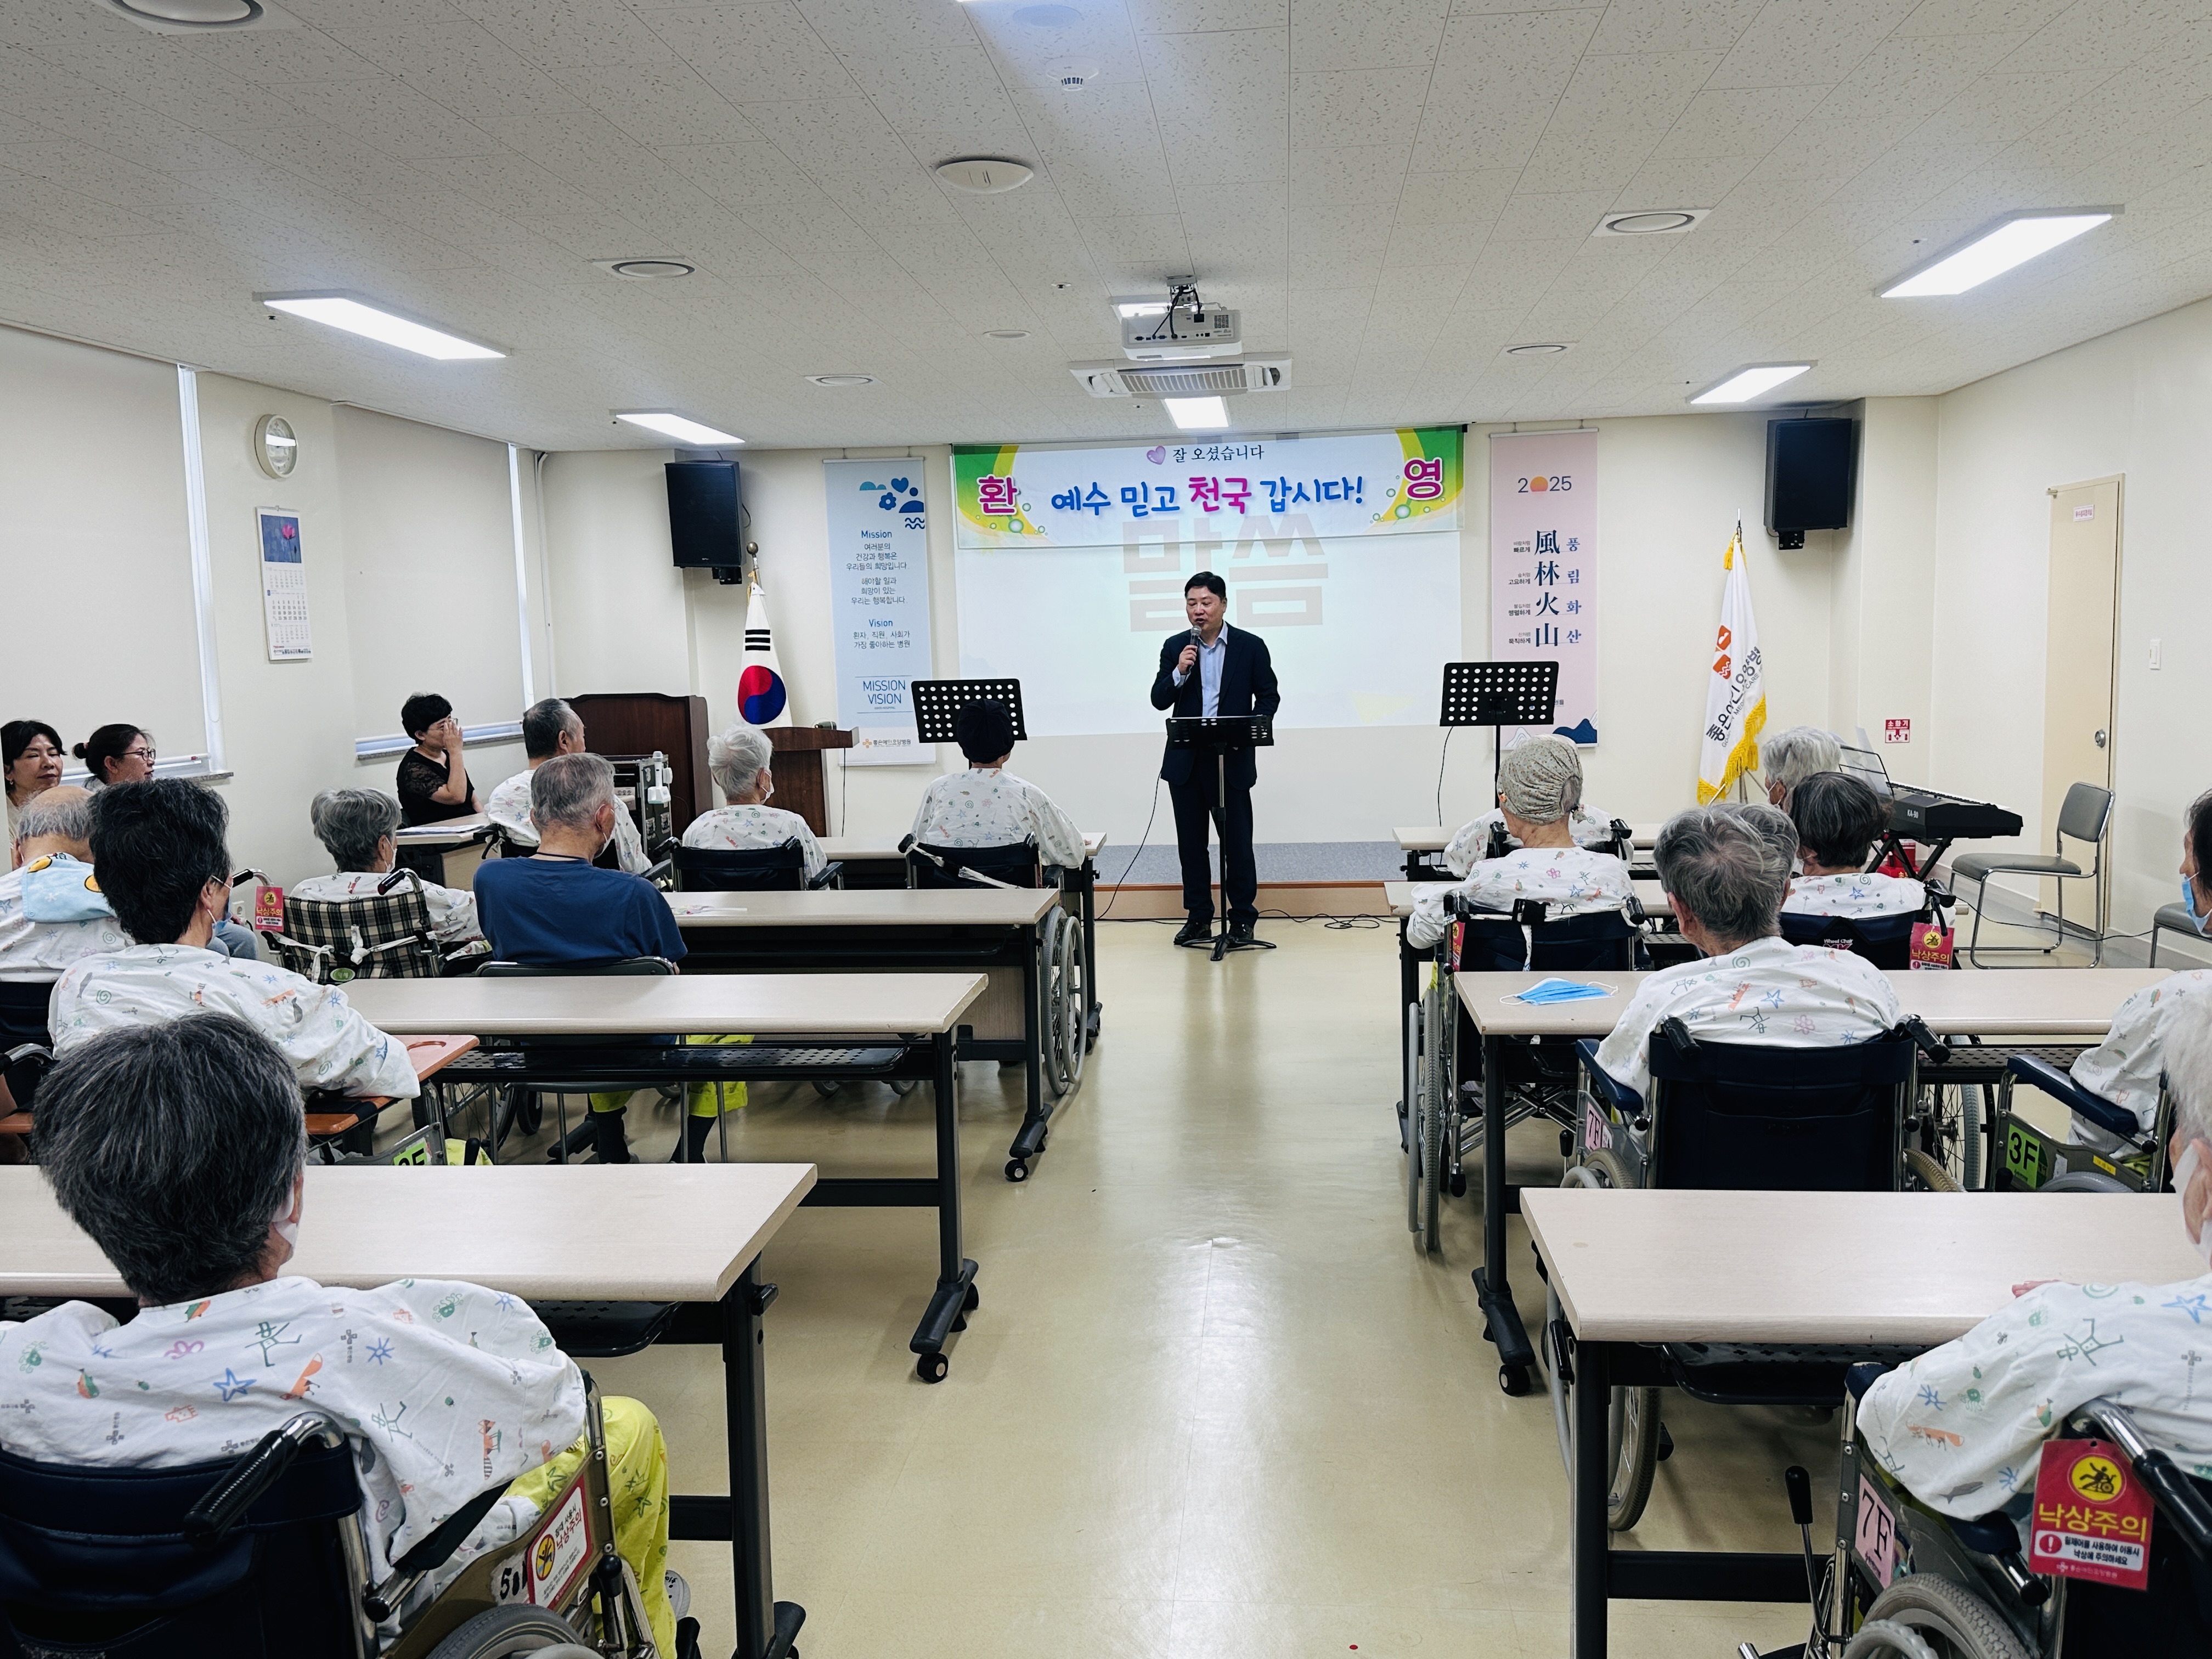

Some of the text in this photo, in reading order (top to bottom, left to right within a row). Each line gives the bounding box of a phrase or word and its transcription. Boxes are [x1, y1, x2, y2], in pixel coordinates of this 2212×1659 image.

[1172, 445, 1265, 463] 잘 오셨습니다
[1403, 457, 1443, 499] 영
[977, 475, 1018, 515] 환
[1051, 475, 1363, 518] 예수 믿고 천국 갑시다!
[861, 530, 893, 539] Mission
[864, 543, 890, 551] 여러분의
[856, 552, 898, 561] 건강과 행복은
[846, 562, 872, 571] 우리들의
[1122, 514, 1328, 633] 말씀
[861, 577, 897, 585] 해야할 일과
[1534, 529, 1560, 647] 風林火山
[861, 586, 896, 595] 희망이 있는
[1566, 537, 1582, 644] 풍림화산
[851, 596, 871, 605] 우리는
[868, 619, 893, 628] Vision
[890, 630, 910, 639] 사회가
[854, 640, 910, 649] 가장 좋아하는 병원
[862, 680, 906, 692] MISSION
[867, 693, 902, 704] VISION
[256, 906, 283, 917] 낙상주의
[1911, 948, 1950, 964] 낙상주의
[1588, 1109, 1600, 1147] 7F
[2009, 1131, 2039, 1171] 3F
[565, 1503, 577, 1525] 사용시
[556, 1507, 582, 1550] 낙상주의
[1862, 1487, 1892, 1562] 7F
[2039, 1503, 2147, 1543] 낙상주의
[2064, 1536, 2140, 1557] 휠체어를 사용하여 이동시
[2074, 1549, 2128, 1566] 낙상에 주의하세요
